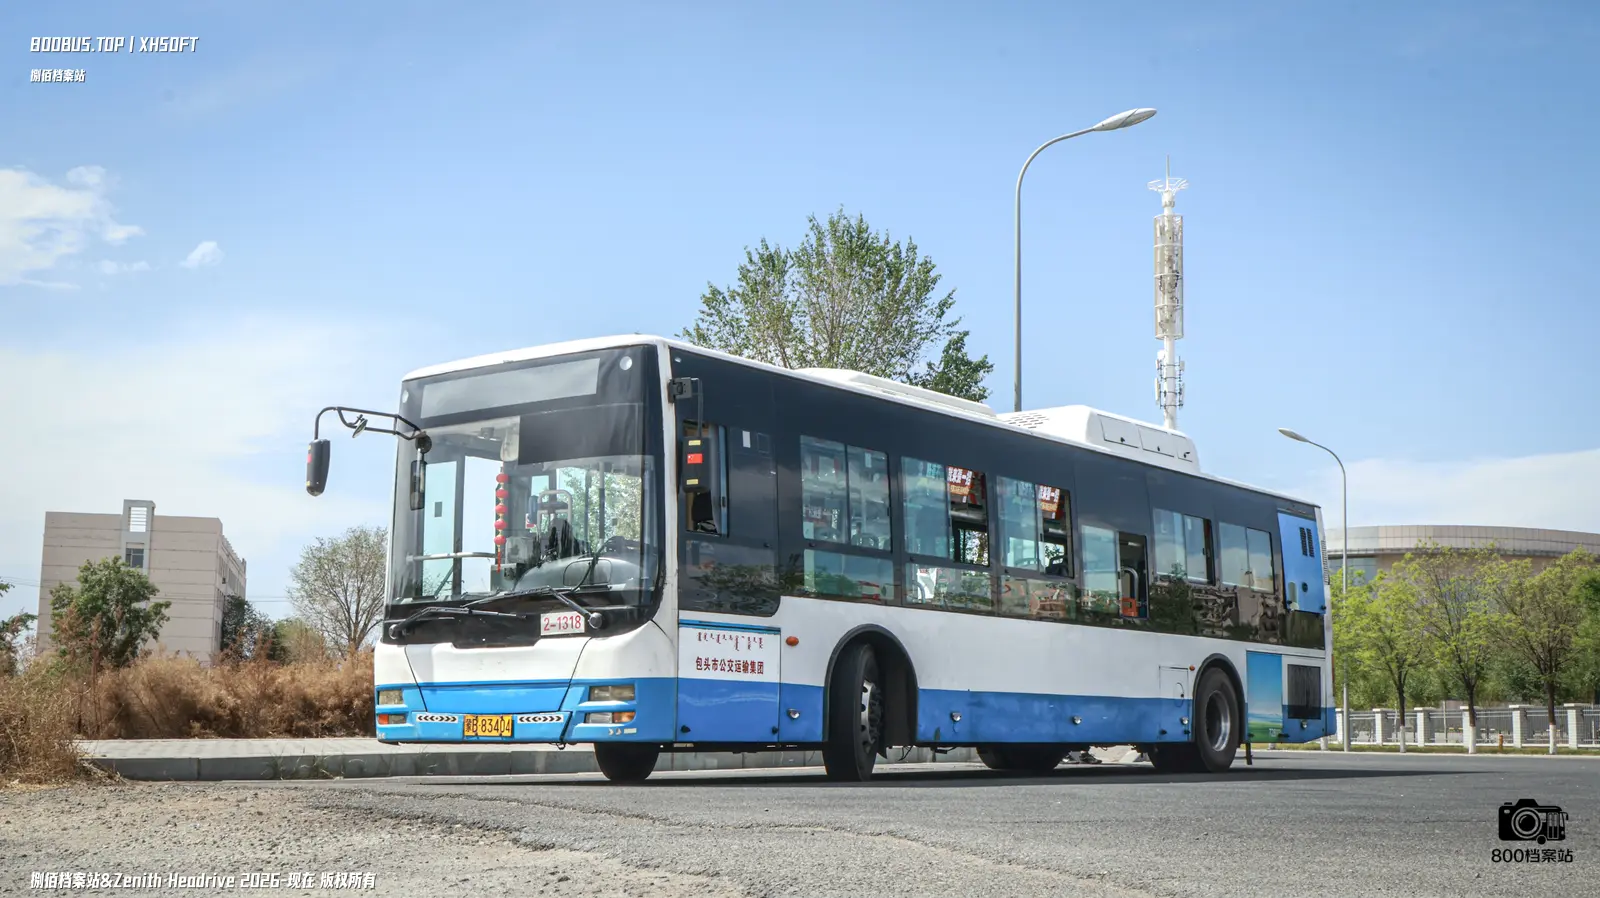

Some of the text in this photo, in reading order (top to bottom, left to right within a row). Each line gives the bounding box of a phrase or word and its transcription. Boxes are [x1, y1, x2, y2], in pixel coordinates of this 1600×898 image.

[543, 615, 582, 632] 2-1318
[695, 656, 765, 675] 包头市公交运输集团
